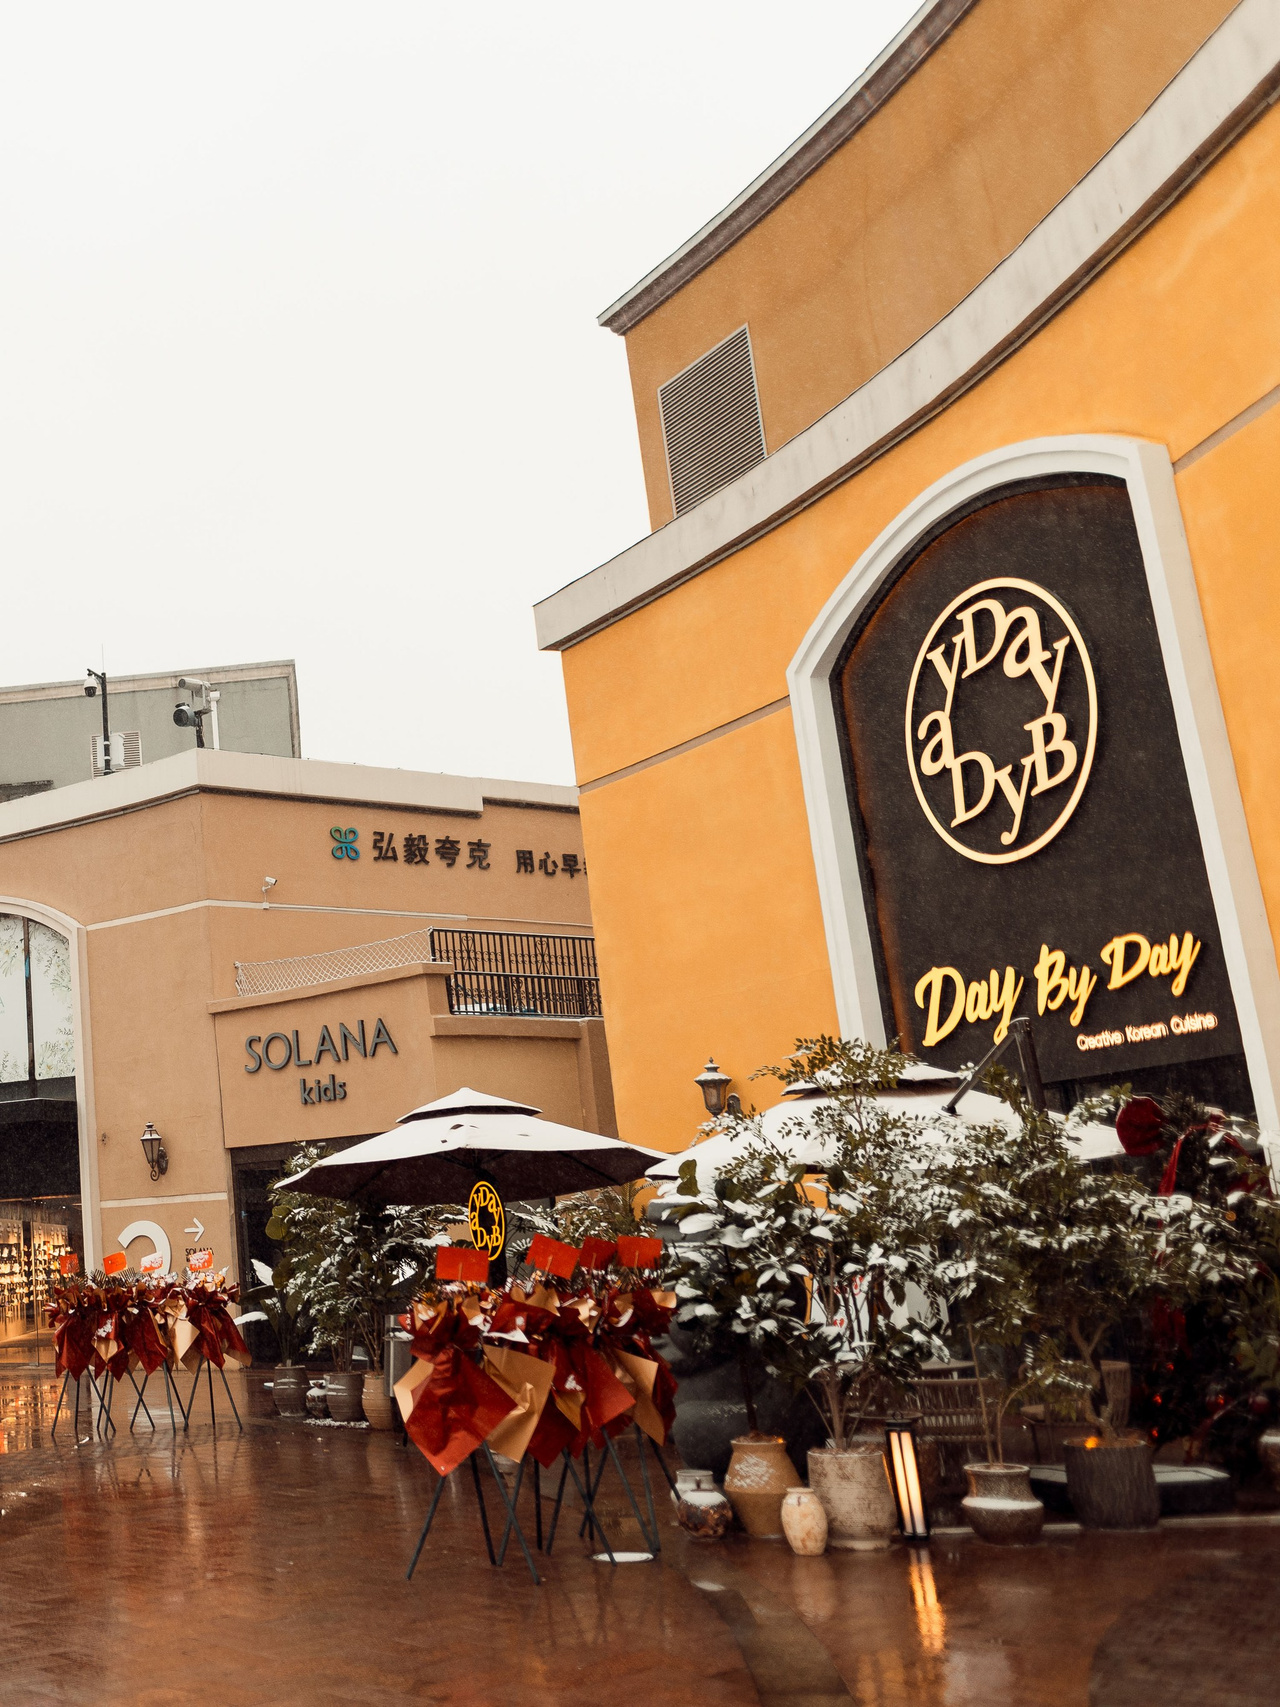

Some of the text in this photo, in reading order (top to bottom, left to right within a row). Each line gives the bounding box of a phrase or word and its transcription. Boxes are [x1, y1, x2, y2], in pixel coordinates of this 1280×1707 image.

[372, 831, 588, 878] 弘毅夸克 用心早
[914, 930, 1201, 1047] Day By Day
[244, 1018, 398, 1073] SOLANA
[1076, 1012, 1218, 1052] Creative Korean Cuisine
[299, 1074, 347, 1104] kids
